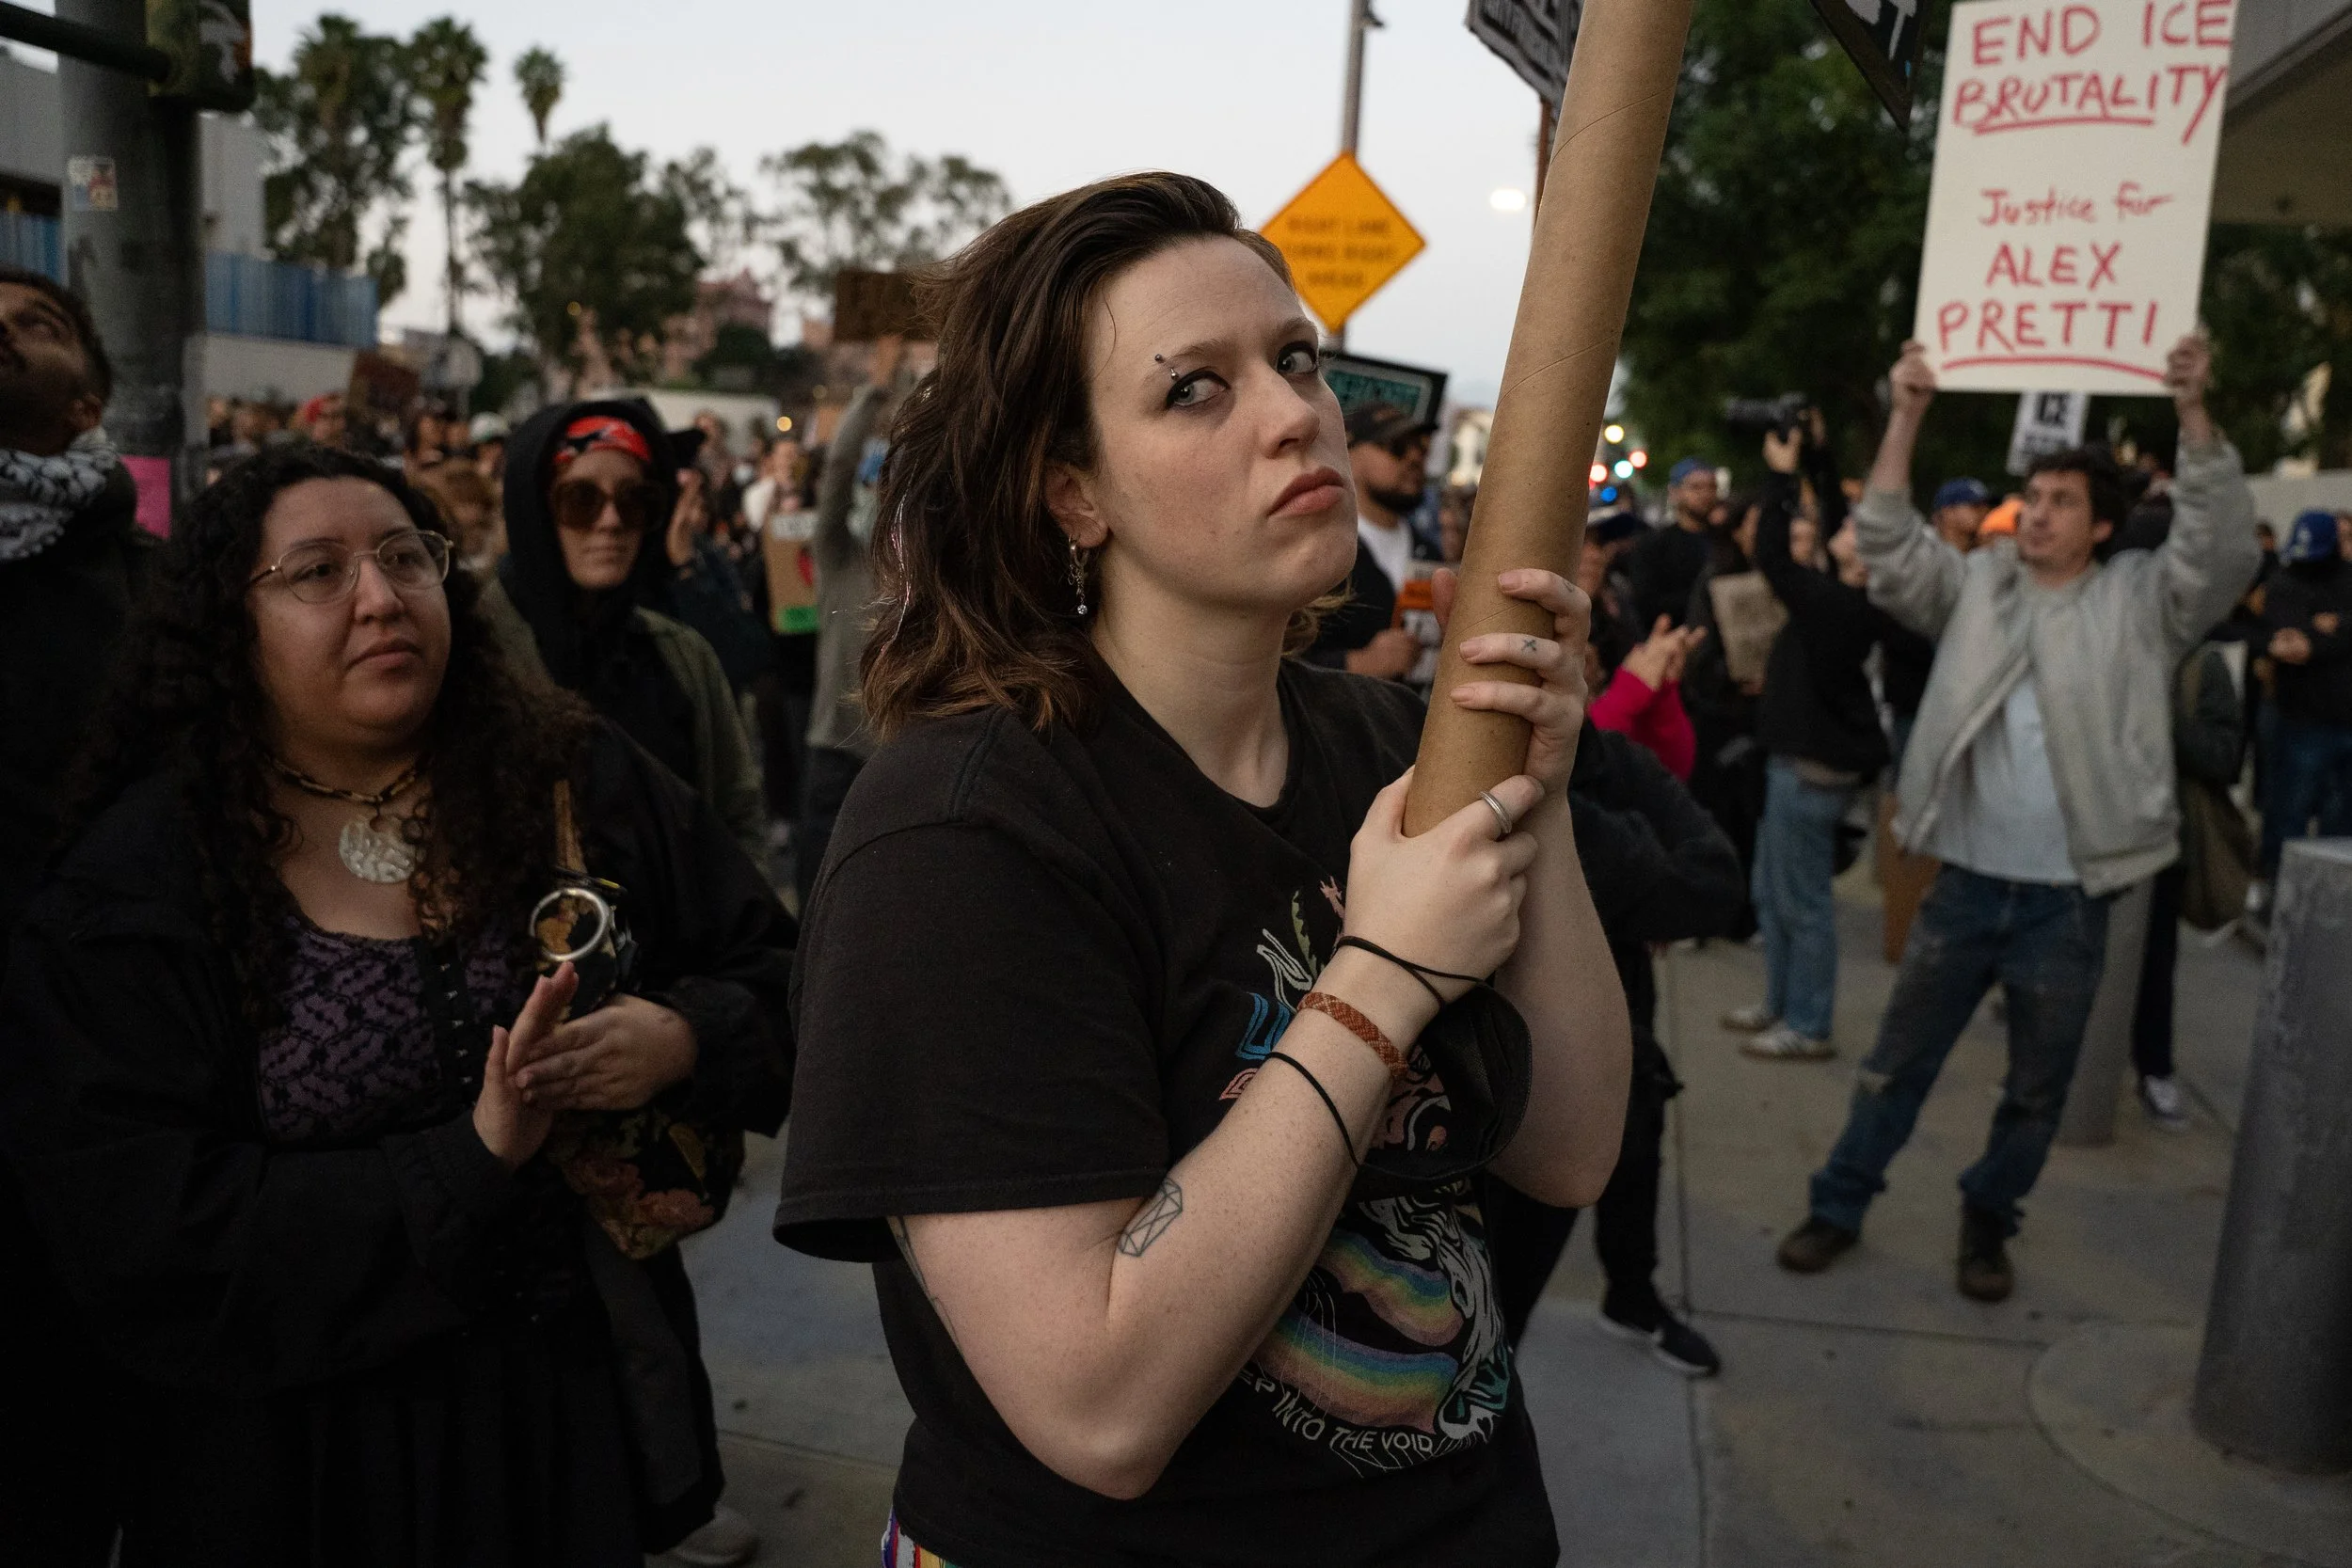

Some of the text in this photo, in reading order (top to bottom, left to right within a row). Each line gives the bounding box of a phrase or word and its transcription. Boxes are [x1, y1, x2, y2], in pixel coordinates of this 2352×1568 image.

[1972, 5, 2101, 67] END
[2142, 0, 2233, 48] ICE
[1951, 63, 2229, 147] BRUTALITY
[1979, 185, 2097, 227] Justice
[1985, 241, 2122, 292] ALEX
[1937, 299, 2158, 354] PRETTI
[1272, 1391, 1326, 1440] INTO
[1329, 1426, 1376, 1449] THE
[1381, 1431, 1433, 1452] VOID
